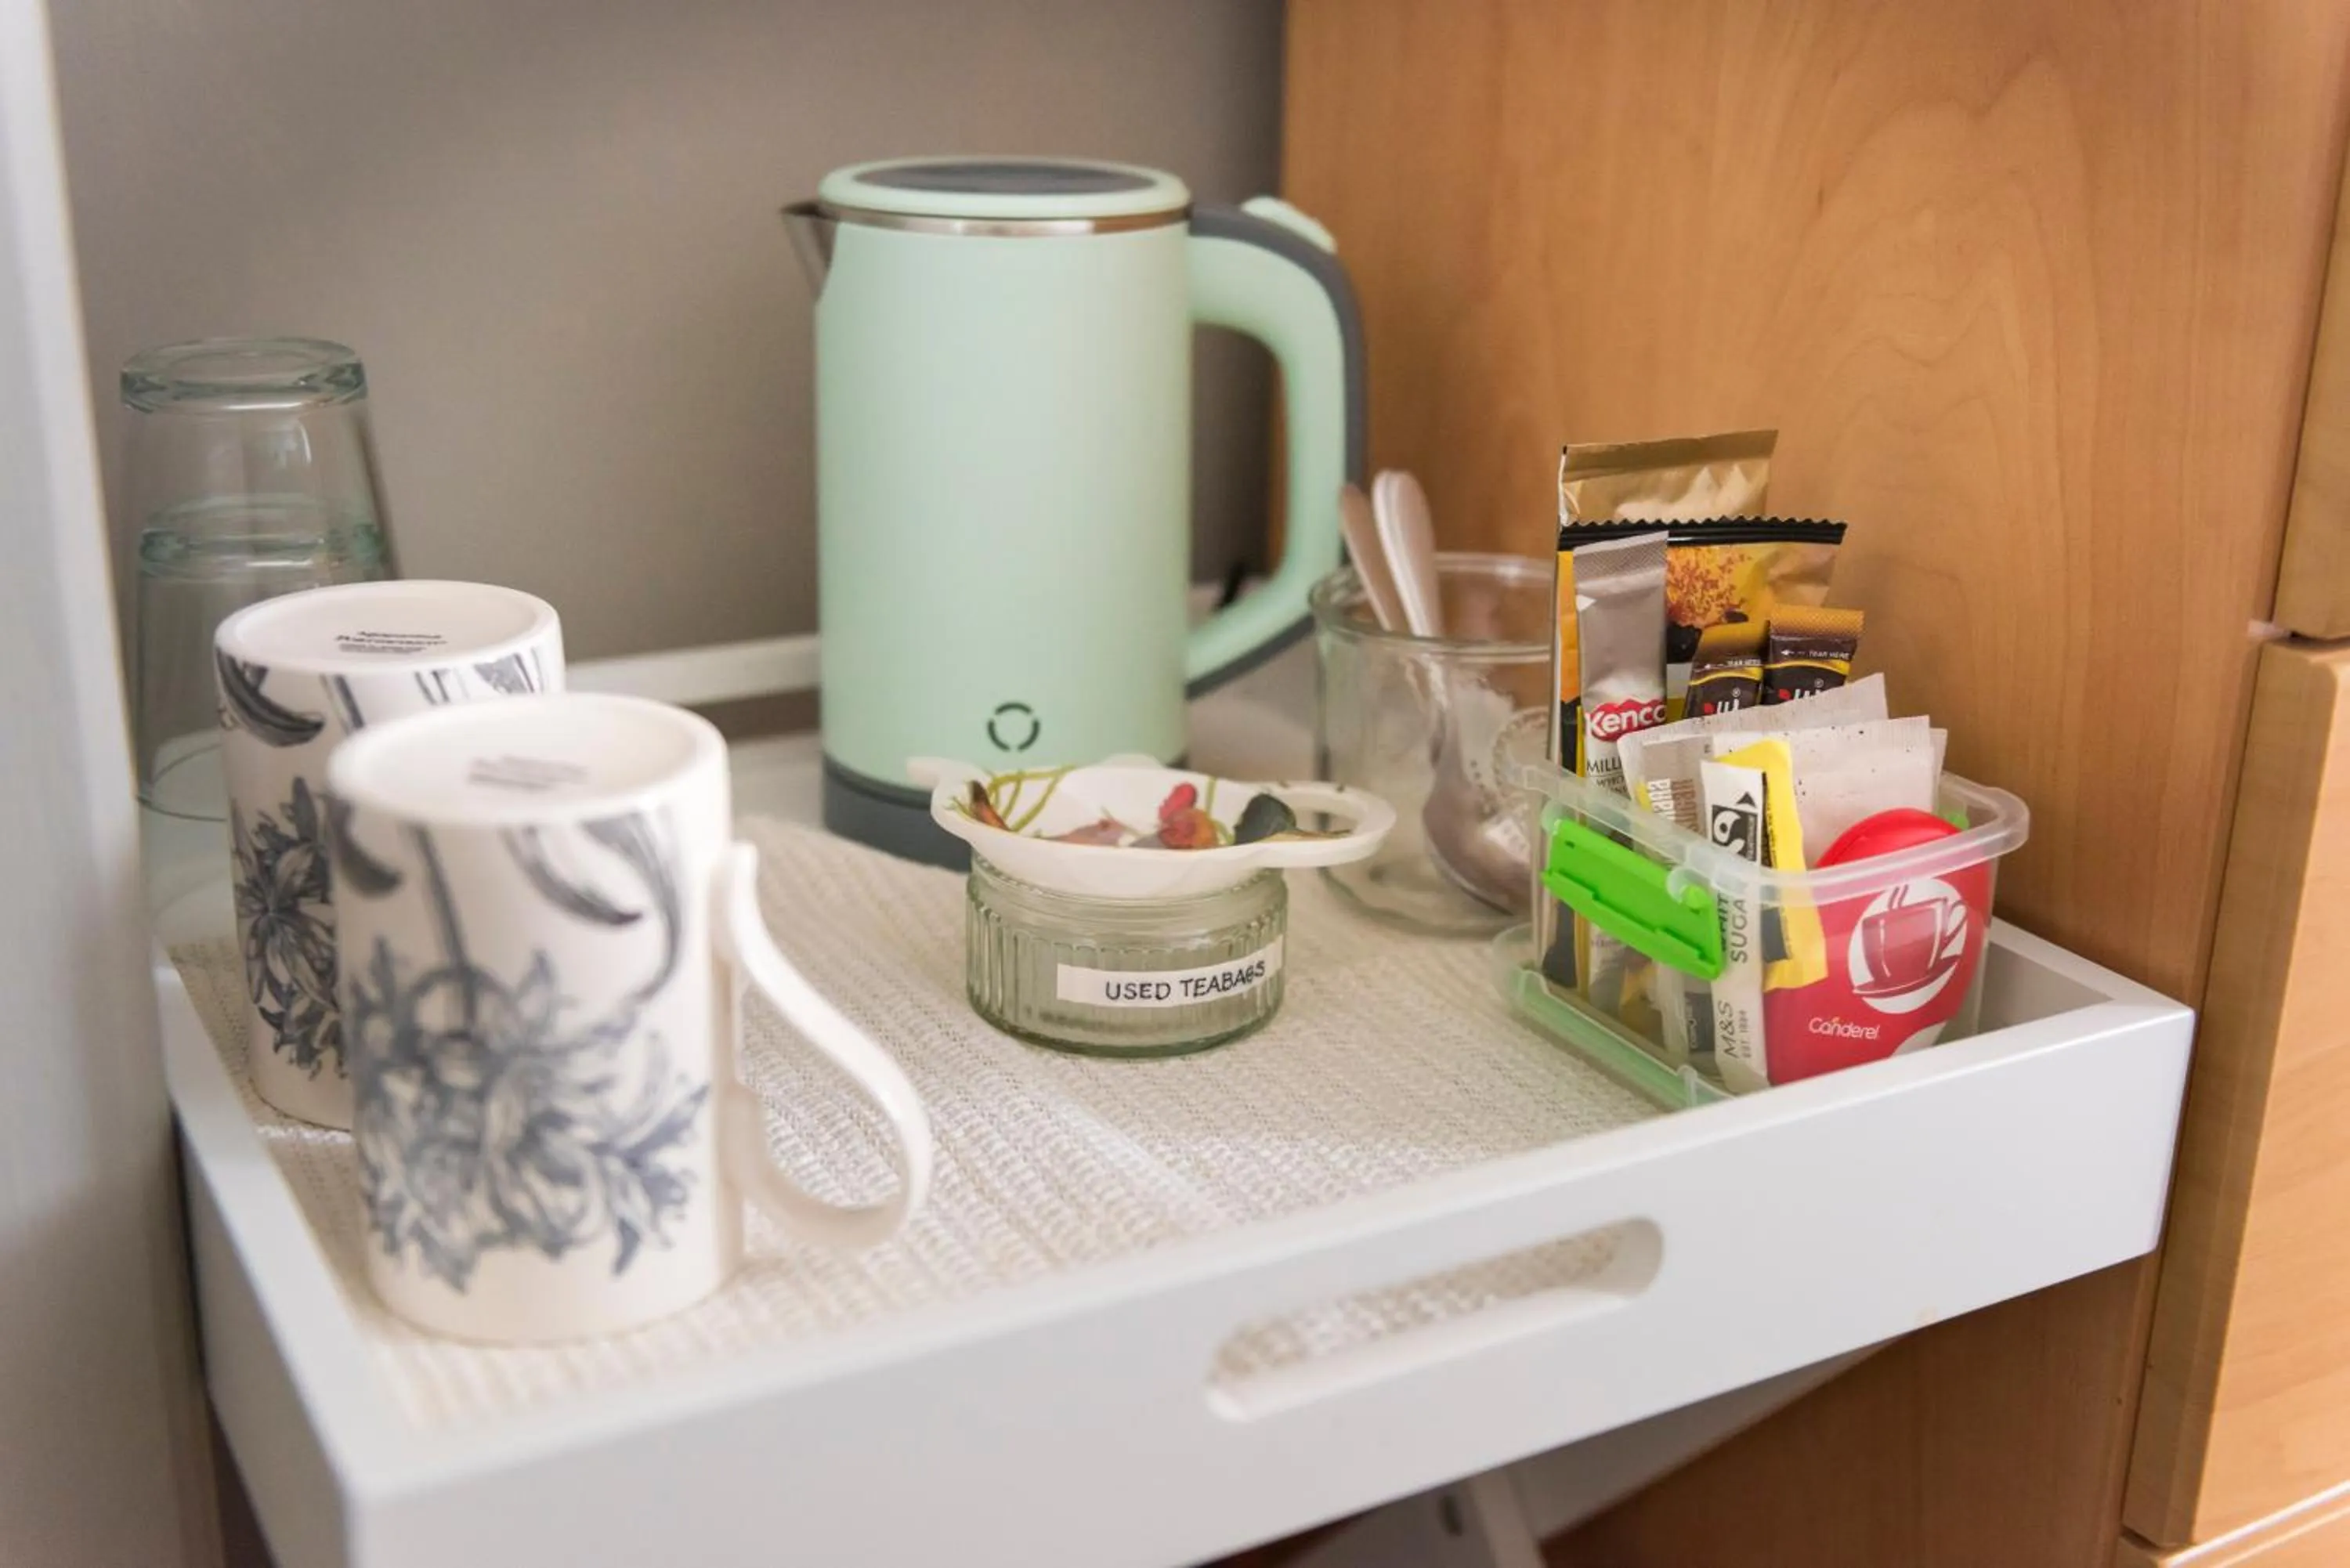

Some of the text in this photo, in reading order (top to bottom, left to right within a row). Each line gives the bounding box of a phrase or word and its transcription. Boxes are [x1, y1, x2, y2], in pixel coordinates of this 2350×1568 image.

[1104, 960, 1266, 1001] USED TEABAGS
[1717, 999, 1740, 1059] M&S
[1808, 1017, 1880, 1040] Canderel
